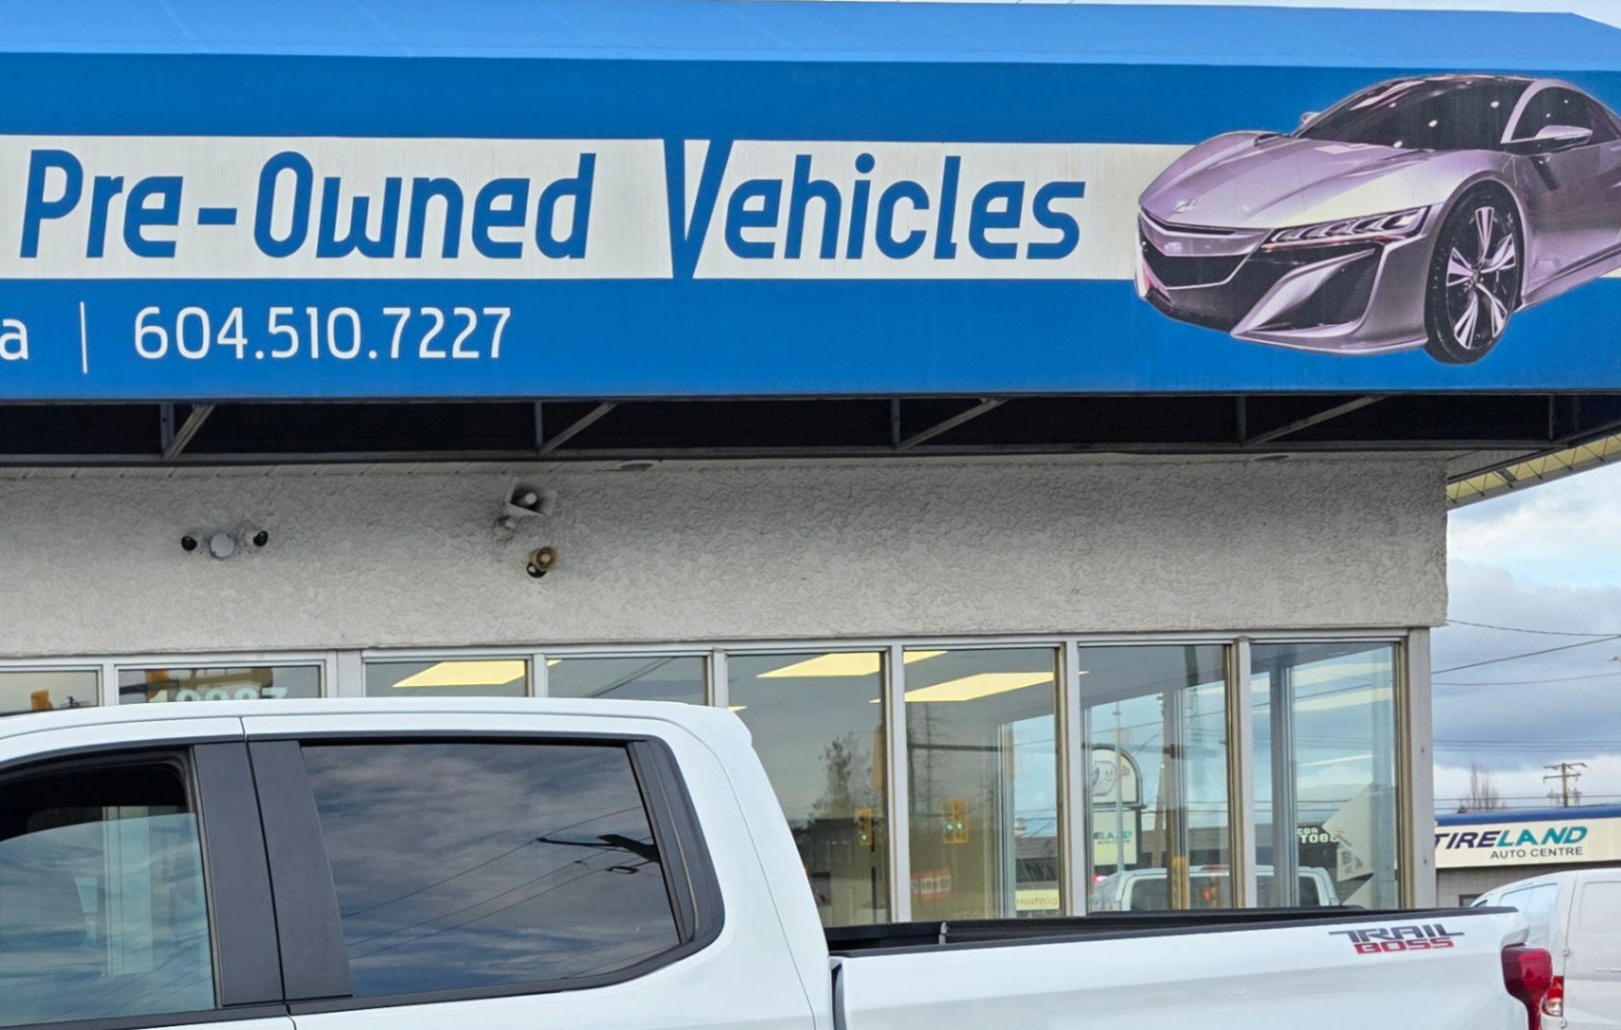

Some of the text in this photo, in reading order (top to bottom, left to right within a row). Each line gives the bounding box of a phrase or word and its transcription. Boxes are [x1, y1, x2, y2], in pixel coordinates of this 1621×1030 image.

[20, 148, 596, 261] Pre-Owned
[663, 139, 1086, 280] Vehicles
[133, 305, 512, 363] 604.510.7227
[1435, 826, 1588, 849] TIRELAND
[1490, 847, 1583, 859] AUTO CENTRE
[1329, 923, 1465, 943] TRAIL
[1353, 937, 1454, 955] BOSS
